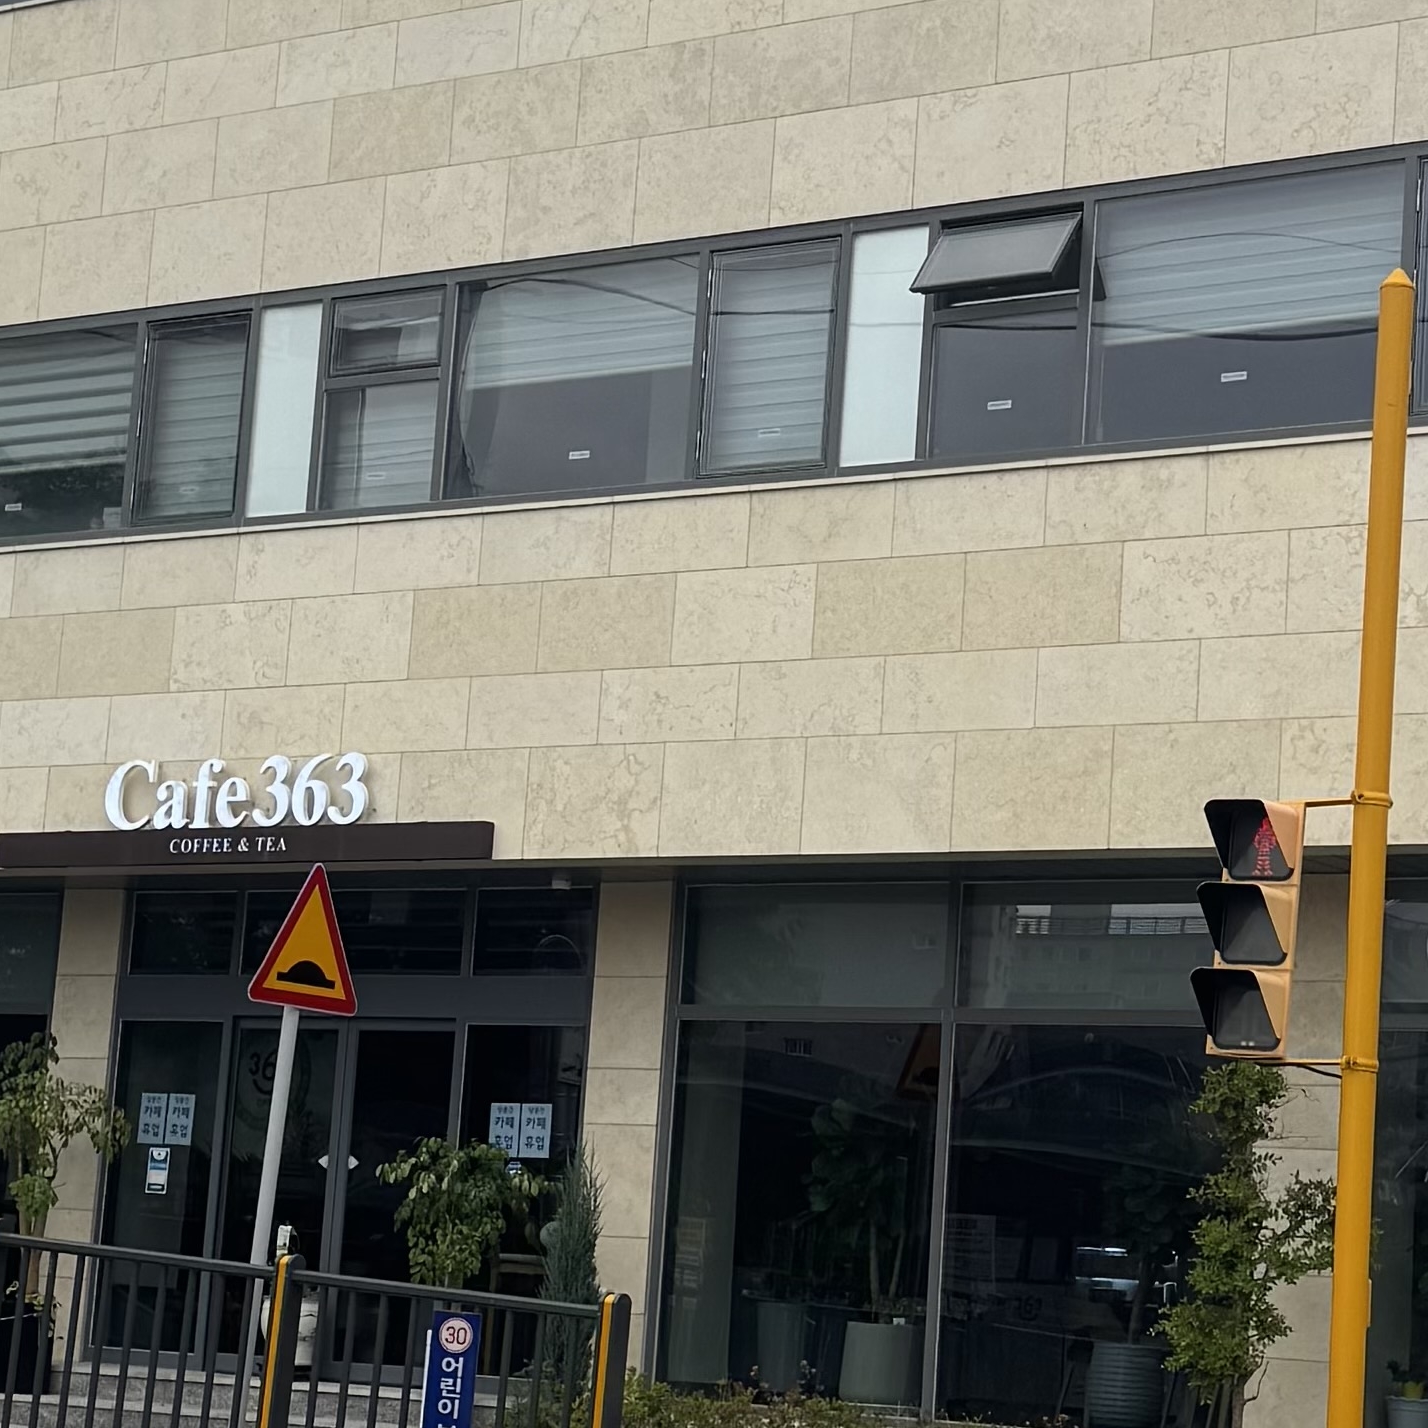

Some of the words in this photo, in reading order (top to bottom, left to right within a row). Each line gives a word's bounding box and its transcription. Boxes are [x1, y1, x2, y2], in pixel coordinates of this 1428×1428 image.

[169, 836, 233, 854] COFFEE
[237, 836, 251, 853] &
[255, 835, 287, 853] TEA
[444, 1326, 468, 1346] 30
[436, 1356, 464, 1420] 어린이
